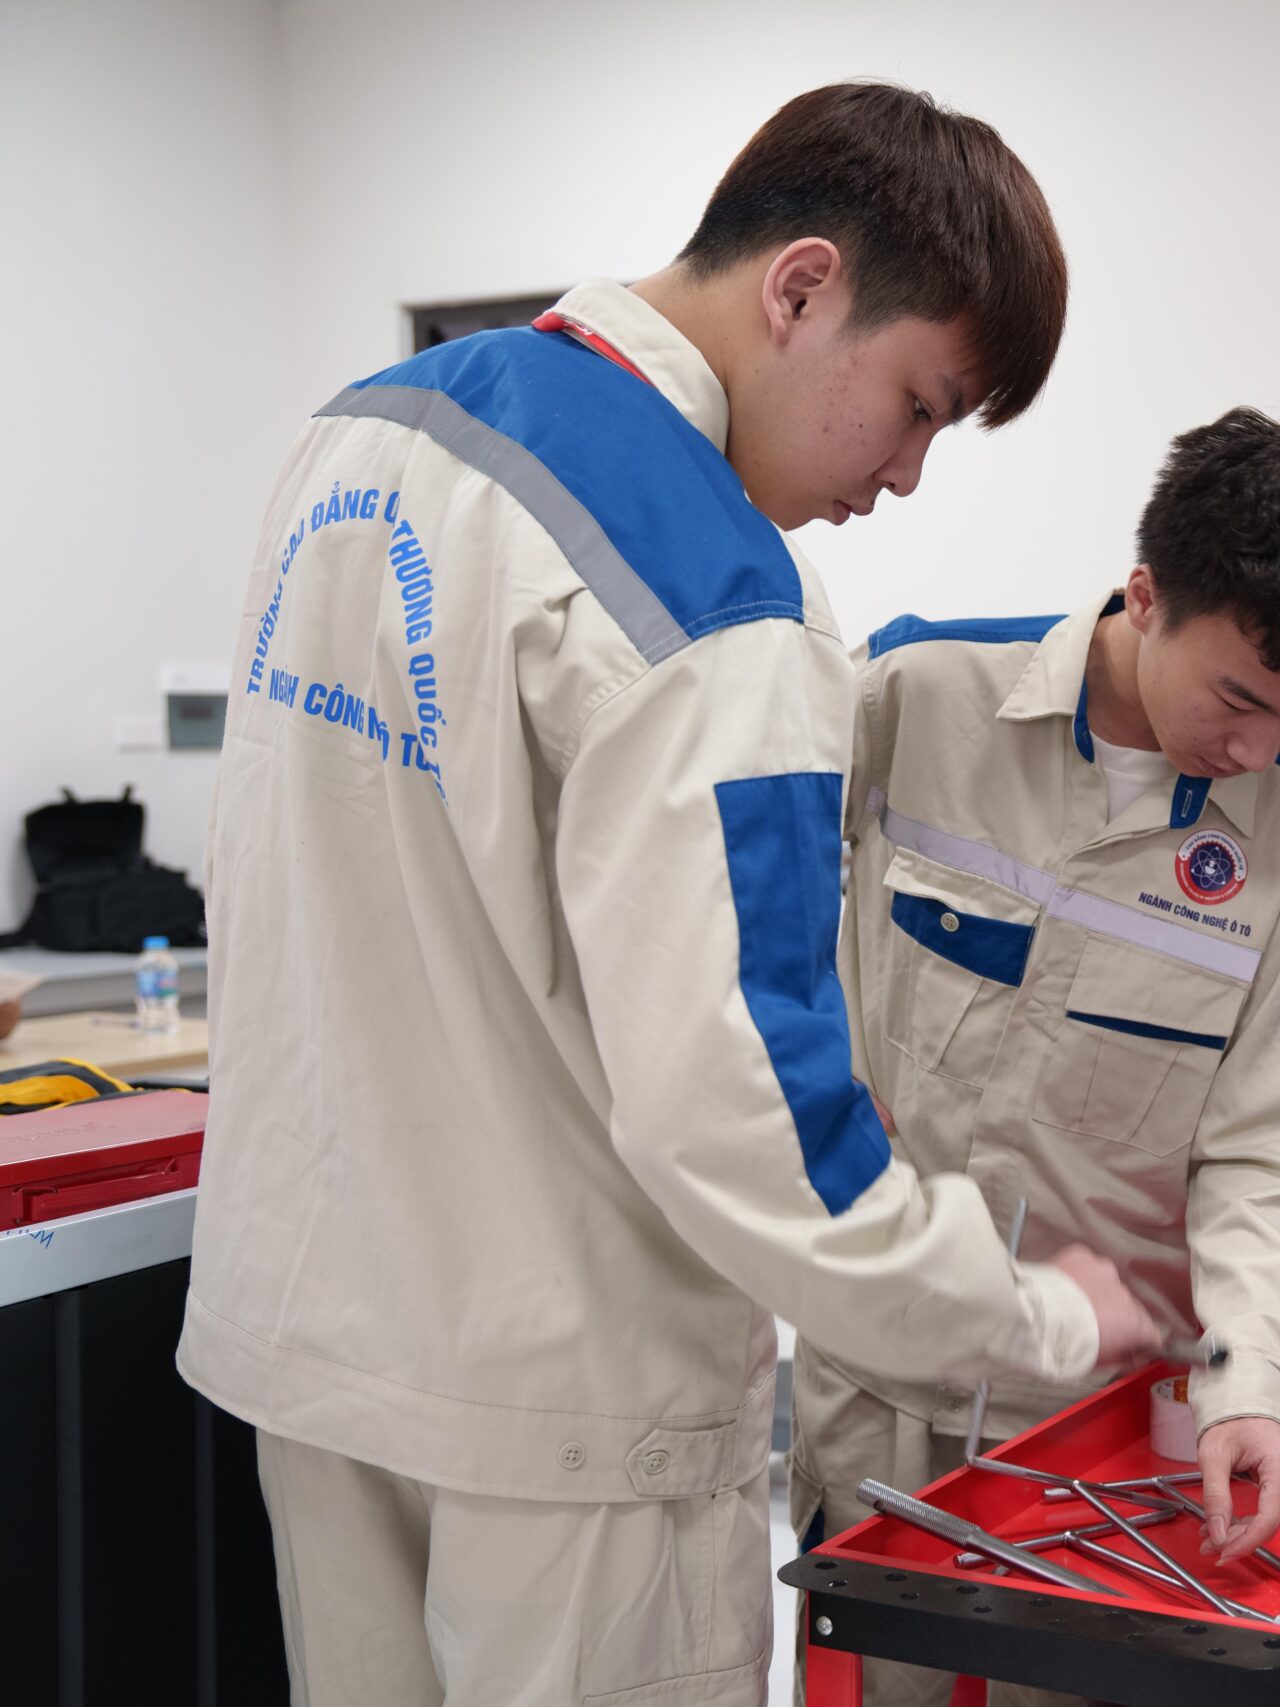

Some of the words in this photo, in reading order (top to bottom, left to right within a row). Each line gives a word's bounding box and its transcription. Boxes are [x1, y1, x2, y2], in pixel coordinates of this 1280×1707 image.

[310, 480, 380, 533] ĐẲNG
[389, 519, 434, 646] THƯƠNG
[303, 683, 365, 735] CÔNG
[409, 653, 447, 749] QUỐC
[1139, 892, 1173, 913] NGÀNH
[1174, 903, 1200, 922] CÔNG
[1201, 914, 1229, 932] NGHỆ
[1230, 920, 1238, 933] Ô
[1240, 924, 1251, 937] TÔ
